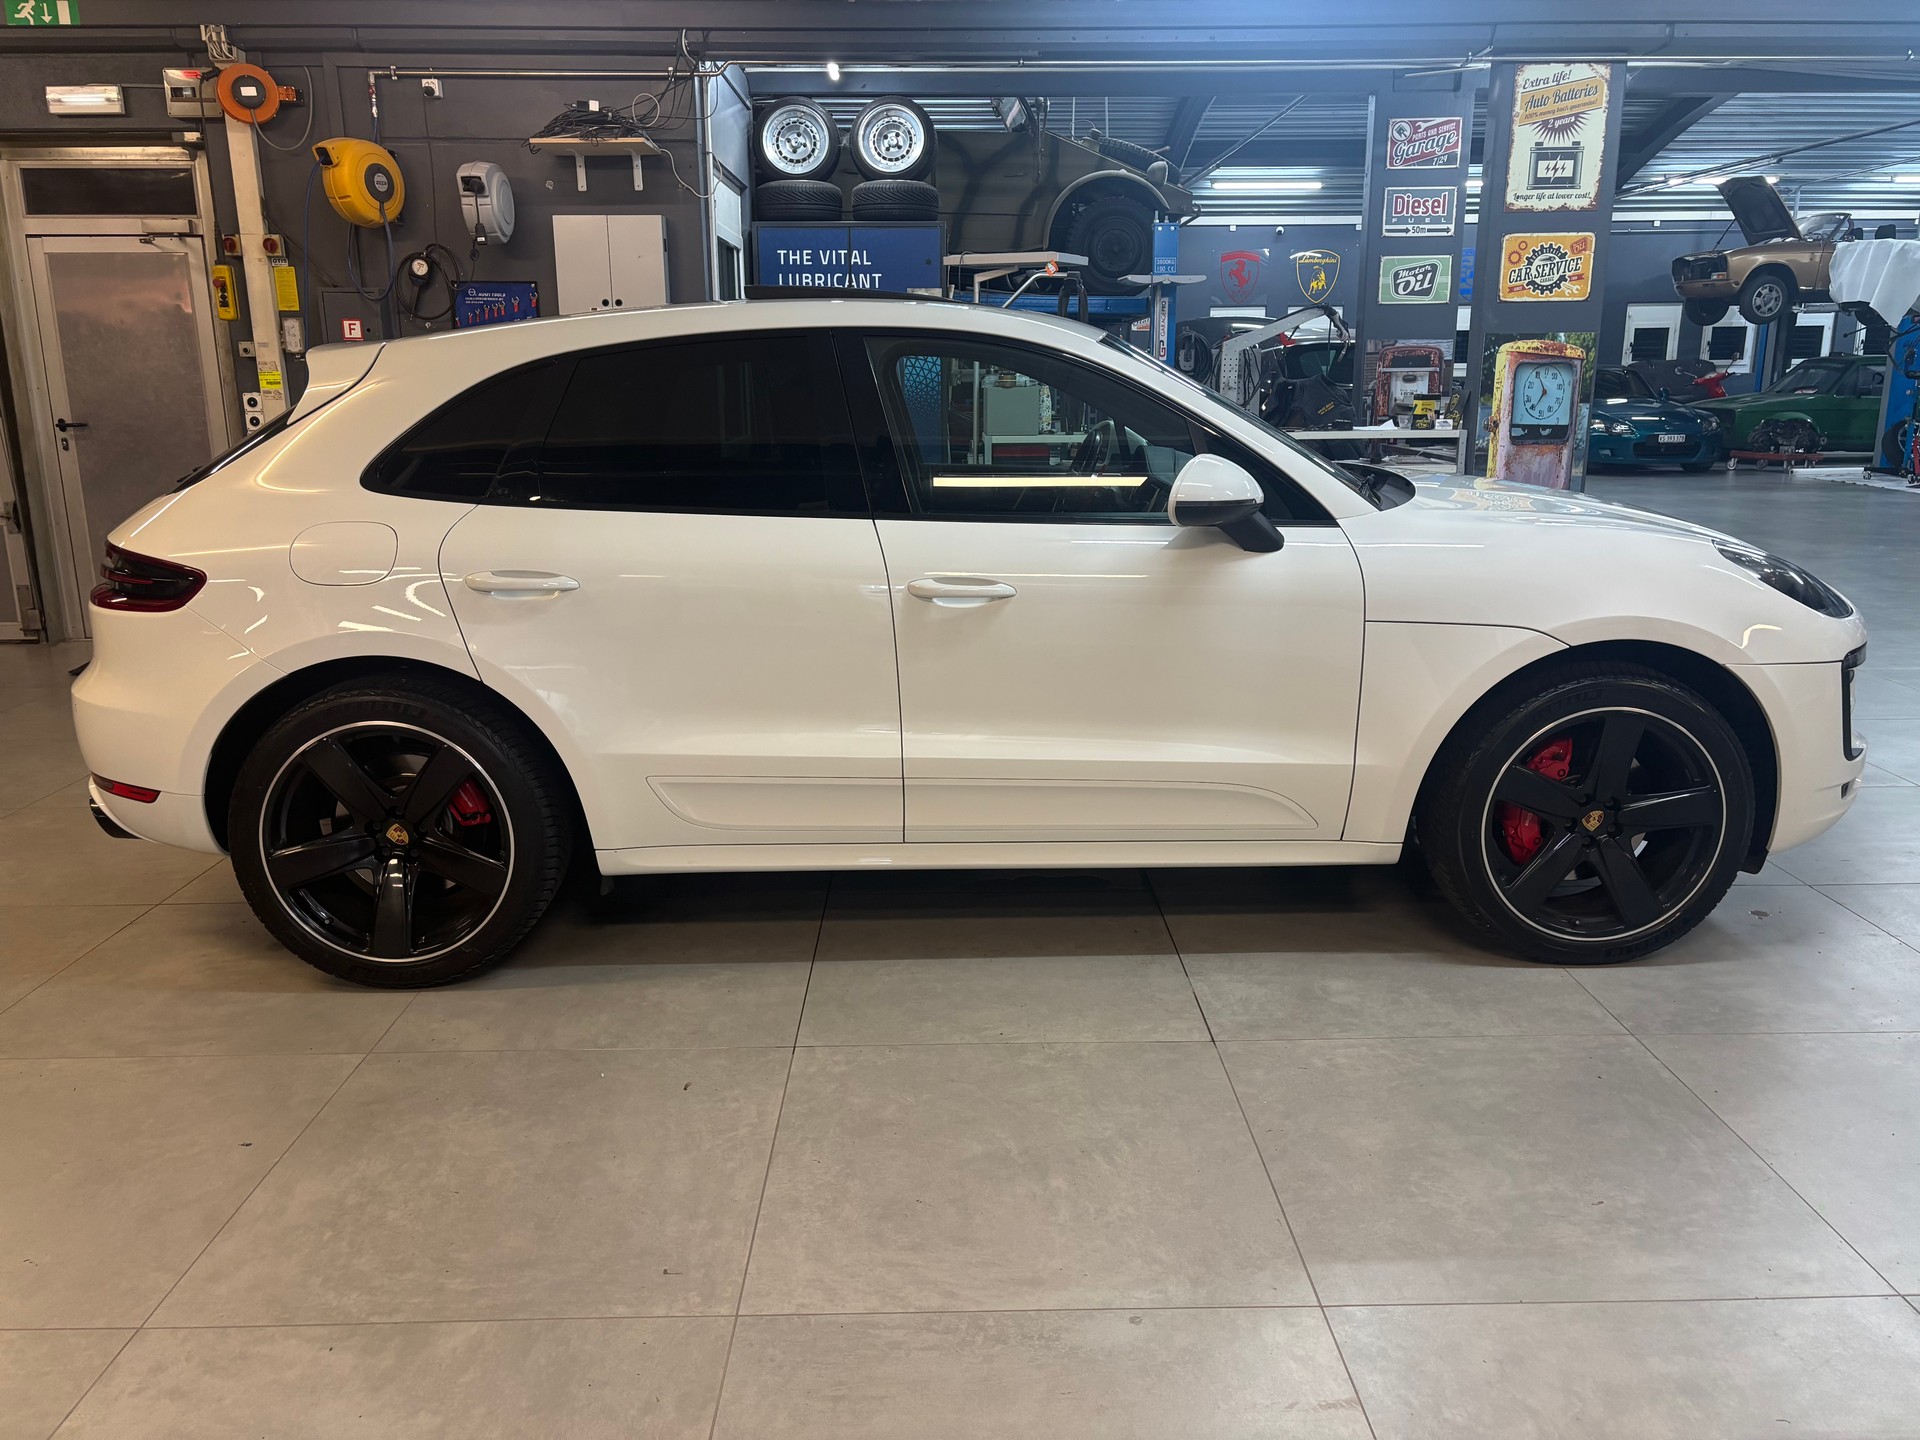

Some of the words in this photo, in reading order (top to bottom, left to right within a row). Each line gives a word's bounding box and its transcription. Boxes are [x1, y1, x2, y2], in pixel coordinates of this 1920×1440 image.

[1522, 76, 1550, 90] Extra
[1552, 69, 1572, 86] life!
[1524, 94, 1551, 112] Auto
[1553, 84, 1598, 104] Batteries
[1548, 119, 1553, 128] 2
[1554, 116, 1575, 128] years
[1412, 131, 1427, 141] PARTS
[1427, 128, 1438, 137] AND
[1438, 122, 1457, 134] SERVICE
[1393, 131, 1458, 165] Garage
[1393, 192, 1448, 216] Diesel
[1513, 193, 1535, 202] Longer
[1536, 192, 1546, 201] life
[1547, 192, 1555, 200] at
[1556, 192, 1574, 200] lower
[1574, 192, 1591, 200] cost!
[1411, 226, 1427, 234] 50m
[777, 250, 813, 265] THE
[819, 250, 872, 265] VITAL
[1298, 255, 1338, 265] Lamborghini
[1397, 265, 1432, 279] Motor
[1508, 266, 1533, 284] CAR
[1533, 256, 1583, 280] SERVICE
[778, 273, 882, 288] LUBRICANT
[1396, 272, 1433, 295] Oil
[347, 323, 357, 336] F
[1527, 381, 1535, 390] 20
